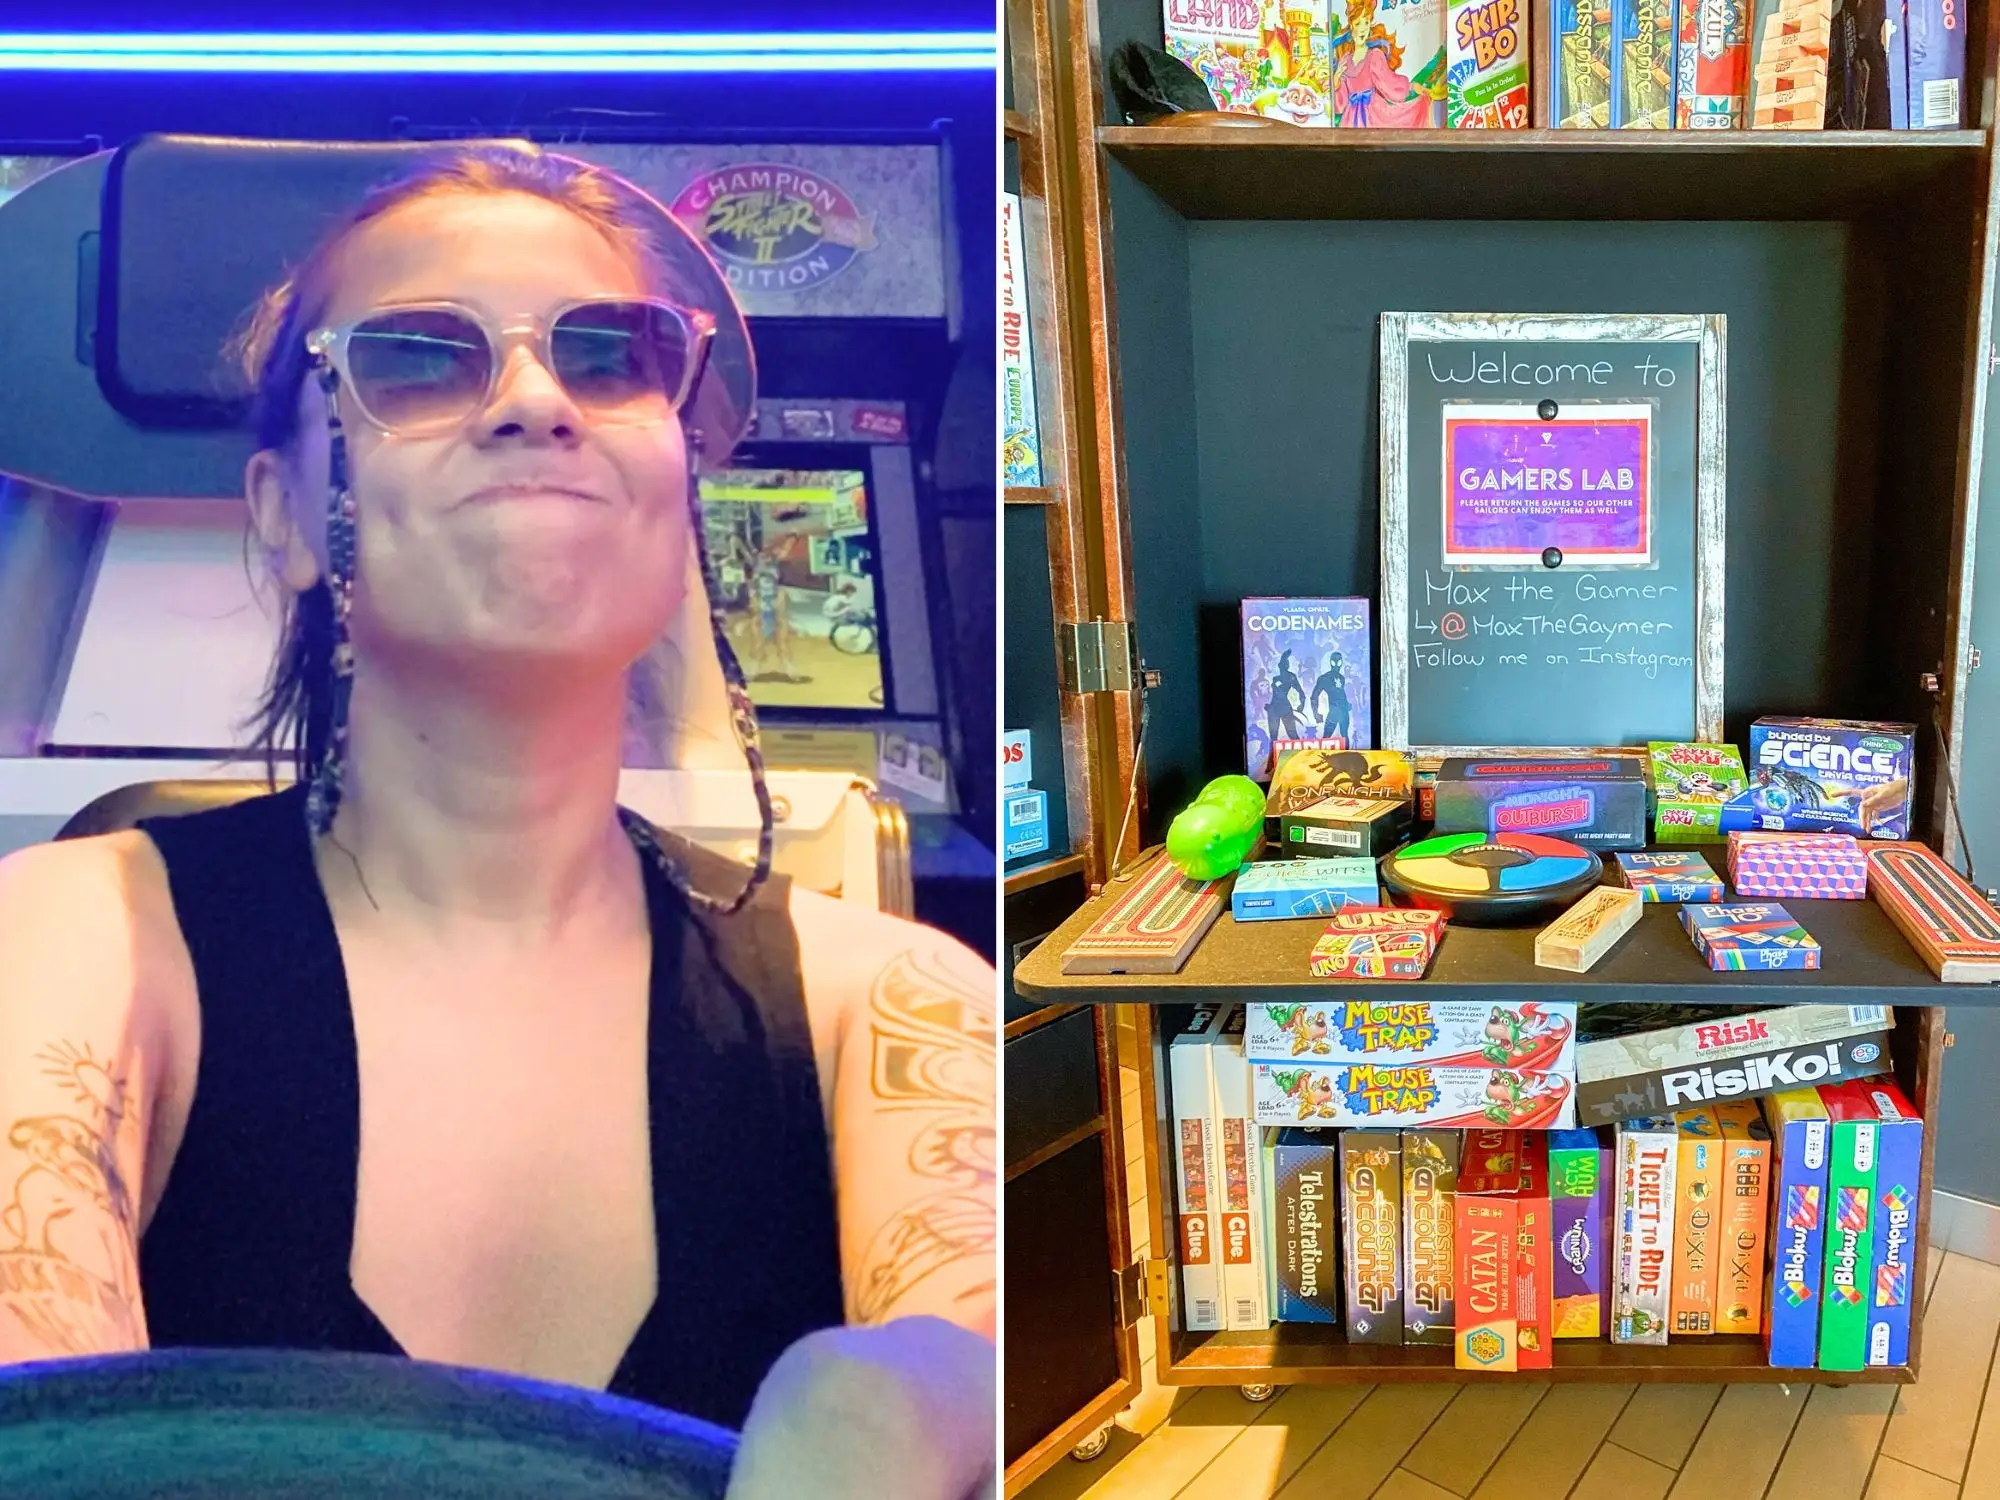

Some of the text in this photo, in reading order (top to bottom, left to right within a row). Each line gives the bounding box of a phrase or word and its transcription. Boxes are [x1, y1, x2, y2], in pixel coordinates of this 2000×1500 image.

[1168, 0, 1261, 30] LAND
[1706, 0, 1722, 44] ZUL
[1474, 27, 1517, 72] BO
[1475, 88, 1486, 97] Fun
[1499, 74, 1516, 87] Order!
[1504, 104, 1528, 129] 12
[690, 171, 836, 210] CHAMPION
[726, 256, 831, 287] DITION
[1004, 311, 1022, 364] RIDE
[1427, 351, 1676, 388] Welcome to
[1006, 366, 1023, 425] EUROPE
[1459, 467, 1635, 491] GAMERS LAB
[1460, 499, 1633, 507] PLEASE RETURN THE GAMES SO OUR OTHER
[1474, 506, 1619, 514] SAILORS CAN ENJOY THEM AS WELL
[1425, 569, 1678, 606] Max the Gamer
[1247, 614, 1364, 632] CODENAMES
[1413, 641, 1694, 679] Follow me on Instagram
[1814, 733, 1831, 744] by
[1669, 753, 1721, 766] PAKU
[1337, 785, 1396, 798] NIGHT
[1422, 794, 1433, 817] 300
[1496, 799, 1589, 828] OUTBURST!
[1661, 814, 1693, 826] PAKU
[1630, 853, 1691, 864] Phase
[1671, 883, 1697, 894] Phase
[1679, 891, 1692, 901] 10
[1337, 910, 1441, 930] UNO
[1700, 905, 1772, 919] Phase
[1729, 912, 1764, 923] 10
[1311, 955, 1347, 977] UNO
[1760, 948, 1789, 960] Phase
[1767, 956, 1785, 968] 10
[1344, 1001, 1434, 1030] MOUSE
[1356, 1023, 1434, 1054] TRAP
[1695, 1018, 1770, 1051] Risk
[1348, 1064, 1436, 1093] MOUSE
[1661, 1043, 1842, 1107] RisiKo!
[1361, 1087, 1435, 1117] TRAP
[1249, 1174, 1257, 1196] Game
[1564, 1167, 1578, 1197] ACT
[1577, 1156, 1595, 1198] HUM
[1287, 1196, 1297, 1273] AFTER DARK
[1298, 1170, 1324, 1298] Telestrations
[1636, 1148, 1669, 1296] TICKET TO RIDE
[1187, 1217, 1204, 1261] Clue
[1228, 1216, 1246, 1259] Clue
[1884, 1209, 1910, 1268] Blokus
[1783, 1224, 1808, 1282] Blokus
[1832, 1227, 1859, 1286] Blokus
[1469, 1228, 1498, 1314] CATAN
[1500, 1263, 1510, 1285] BUILD
[1500, 1287, 1510, 1312] TRADE
